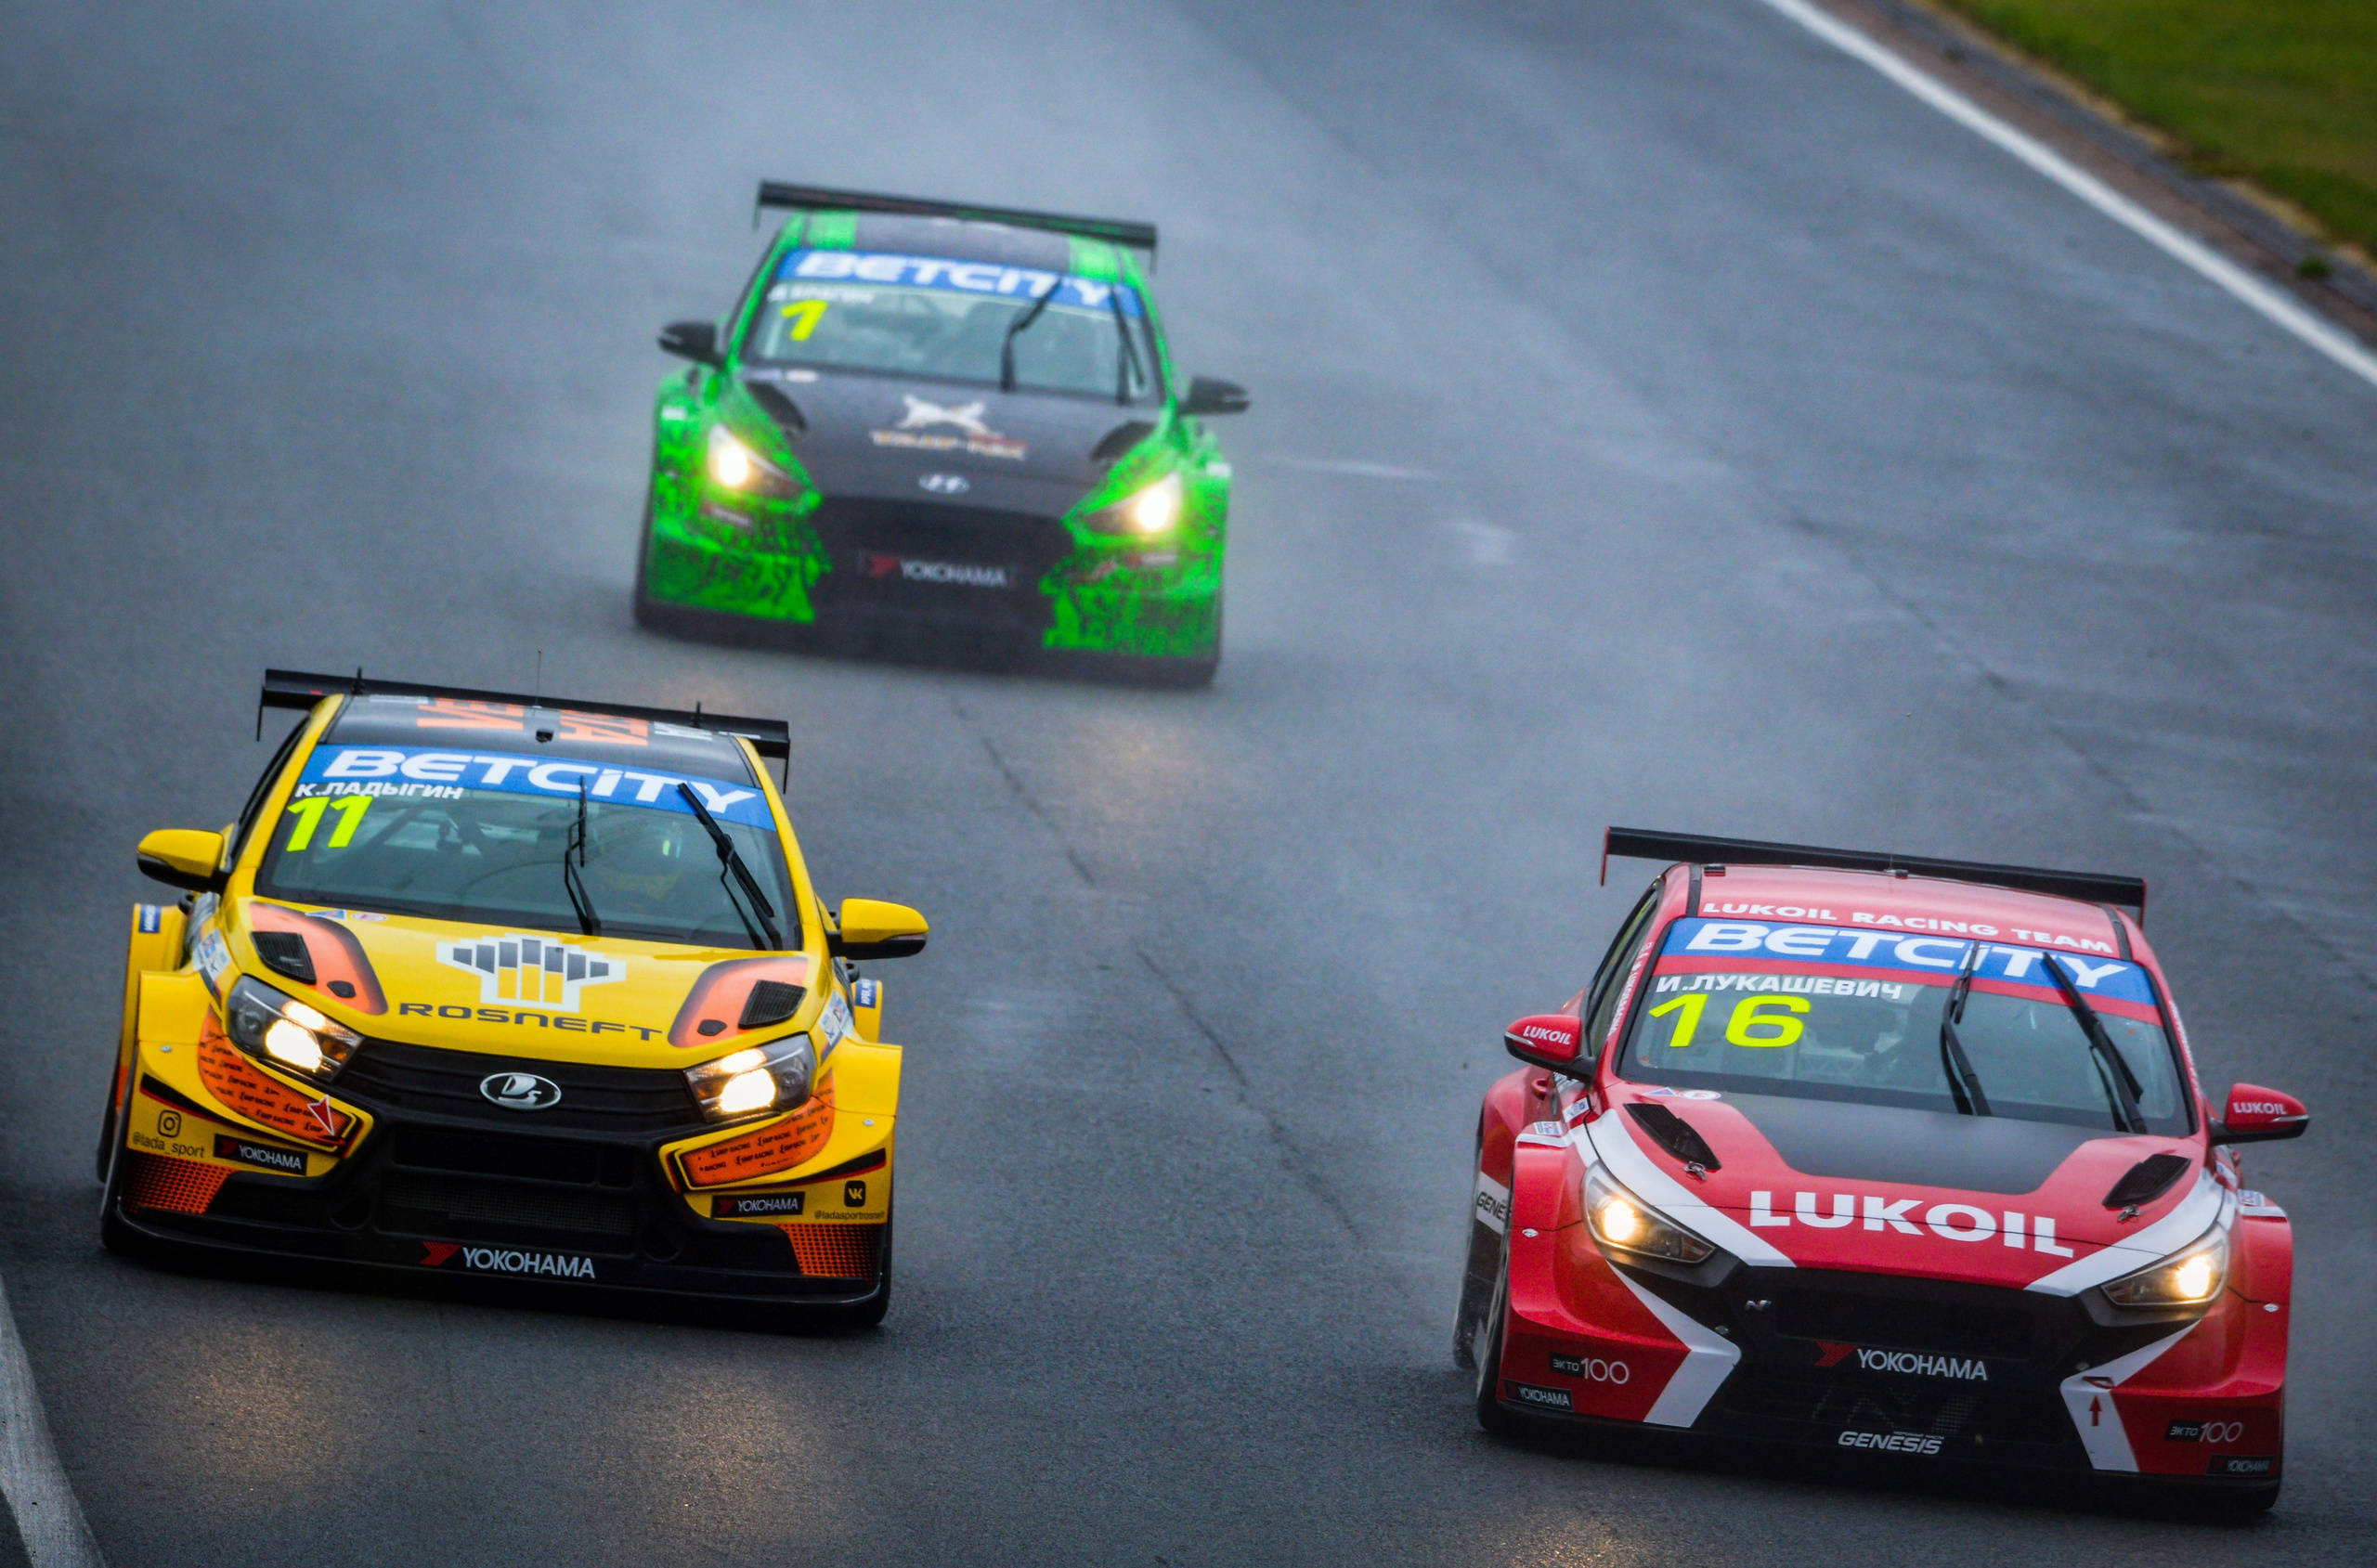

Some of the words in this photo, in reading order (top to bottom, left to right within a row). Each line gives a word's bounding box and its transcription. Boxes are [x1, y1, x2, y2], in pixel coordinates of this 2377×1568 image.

[782, 299, 828, 341] 1
[901, 559, 1007, 589] YOKOHAMA
[295, 782, 464, 800] К.ЛАДЫГИН
[286, 796, 373, 852] 11
[1703, 902, 1838, 921] LUKOIL
[1852, 913, 1999, 937] RACING
[2010, 928, 2113, 953] TEAM
[1656, 976, 1903, 1000] И.ЛУКАШЕВИЧ
[398, 1002, 663, 1041] ROSNEFT
[1648, 993, 1812, 1048] 16
[1523, 1025, 1573, 1045] LUKOIL
[2232, 1101, 2288, 1116] LUKOIL
[132, 1132, 205, 1158] @lada_sport
[239, 1145, 302, 1170] YOKOHAMA
[737, 1198, 799, 1212] YOKOHAMA
[1749, 1190, 2074, 1259] LUKOIL
[462, 1247, 596, 1279] YOKOHAMA
[1580, 1357, 1630, 1385] 100
[1857, 1348, 1989, 1381] YOKOHAMA
[1518, 1386, 1571, 1407] YOKOHAMA
[1838, 1431, 1942, 1455] GENESIS
[2199, 1421, 2243, 1444] 100
